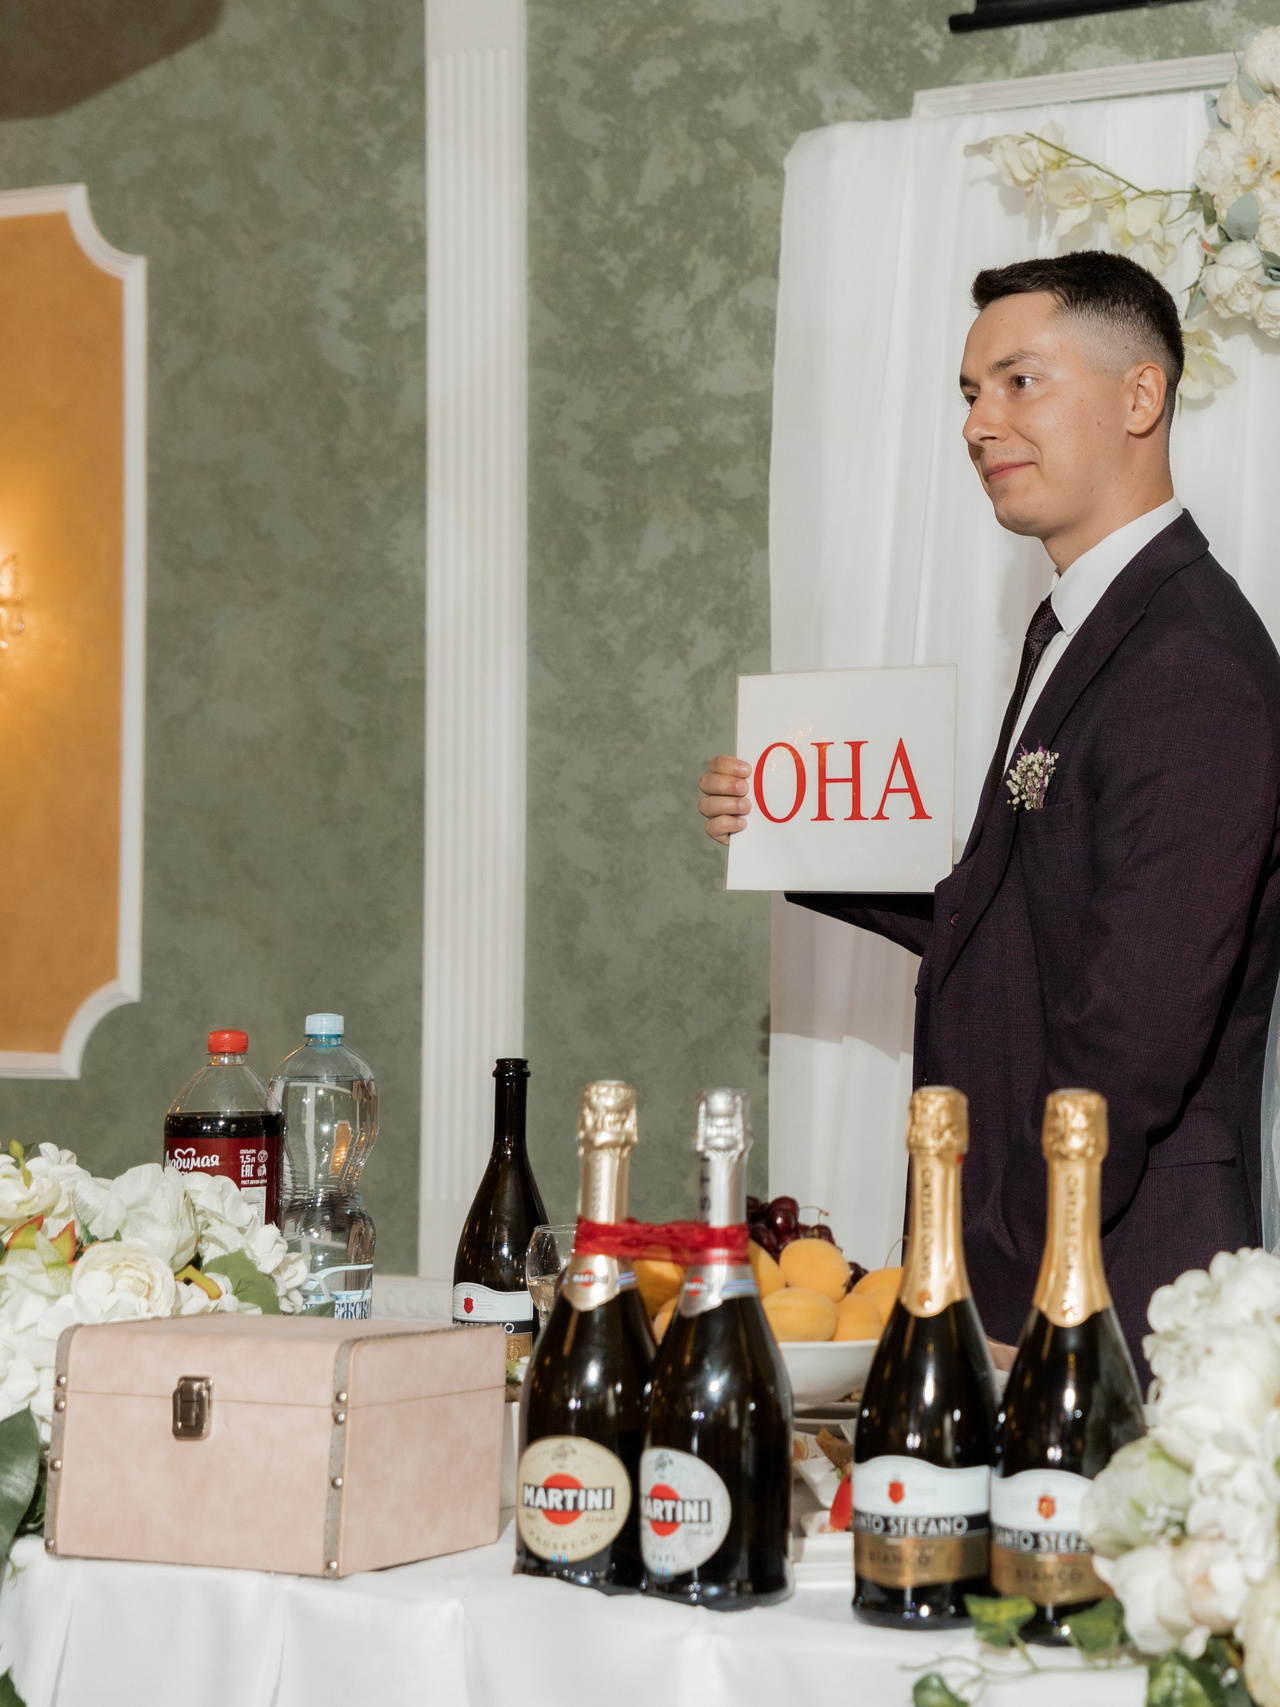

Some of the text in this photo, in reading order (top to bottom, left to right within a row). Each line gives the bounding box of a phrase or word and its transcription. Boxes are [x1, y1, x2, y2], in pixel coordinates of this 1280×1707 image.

[753, 737, 933, 823] ОНА
[523, 1484, 613, 1511] MARTINI
[888, 1515, 969, 1536] STEFANO
